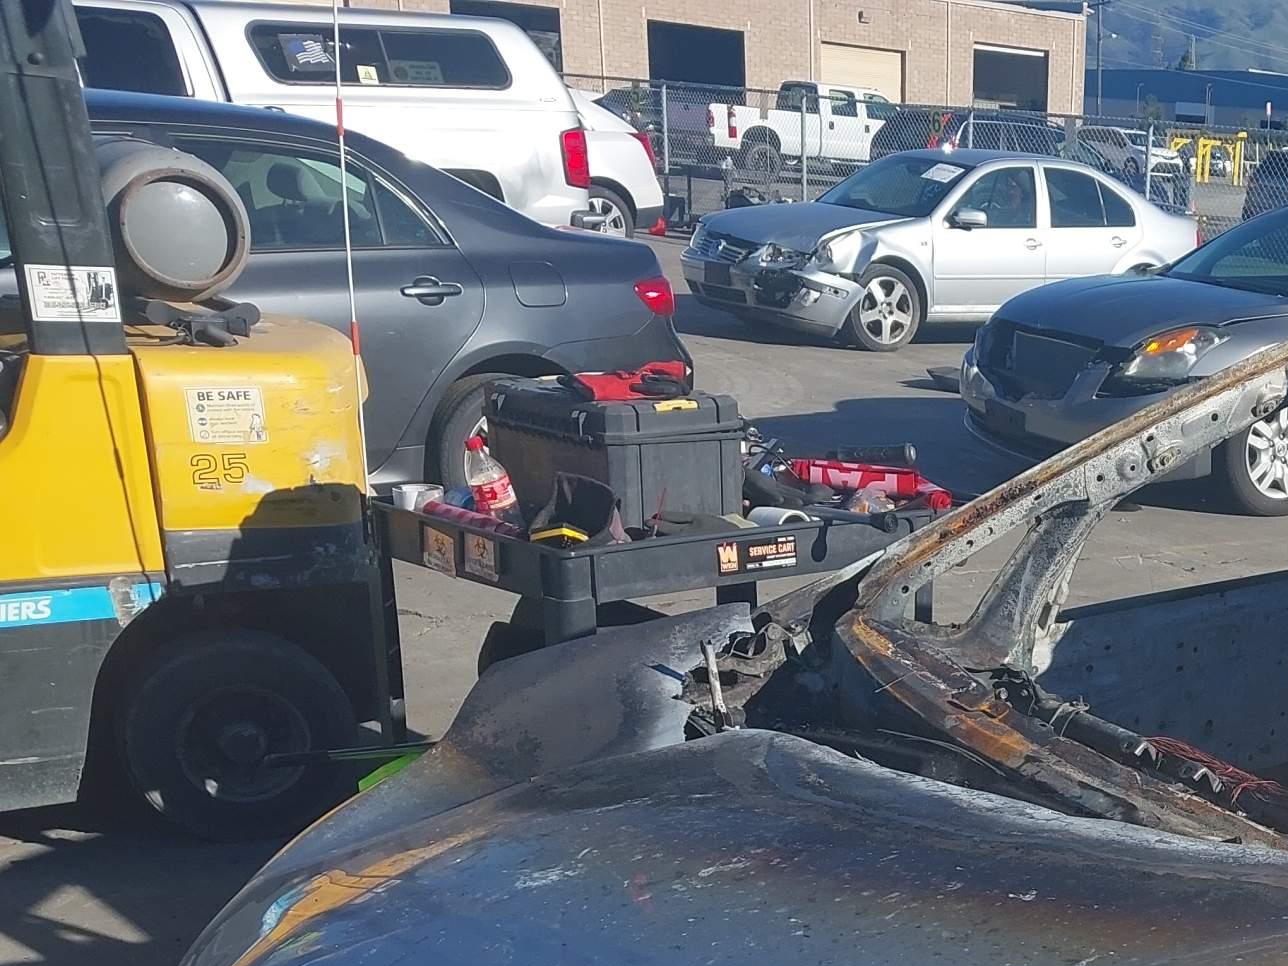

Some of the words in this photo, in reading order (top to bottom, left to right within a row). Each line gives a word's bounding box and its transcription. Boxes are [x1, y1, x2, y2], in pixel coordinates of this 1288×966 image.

[932, 110, 942, 133] 6
[197, 391, 215, 401] BE
[217, 390, 252, 401] SAFE
[190, 453, 250, 486] 25
[749, 544, 778, 557] SERVICE
[777, 542, 795, 554] CART
